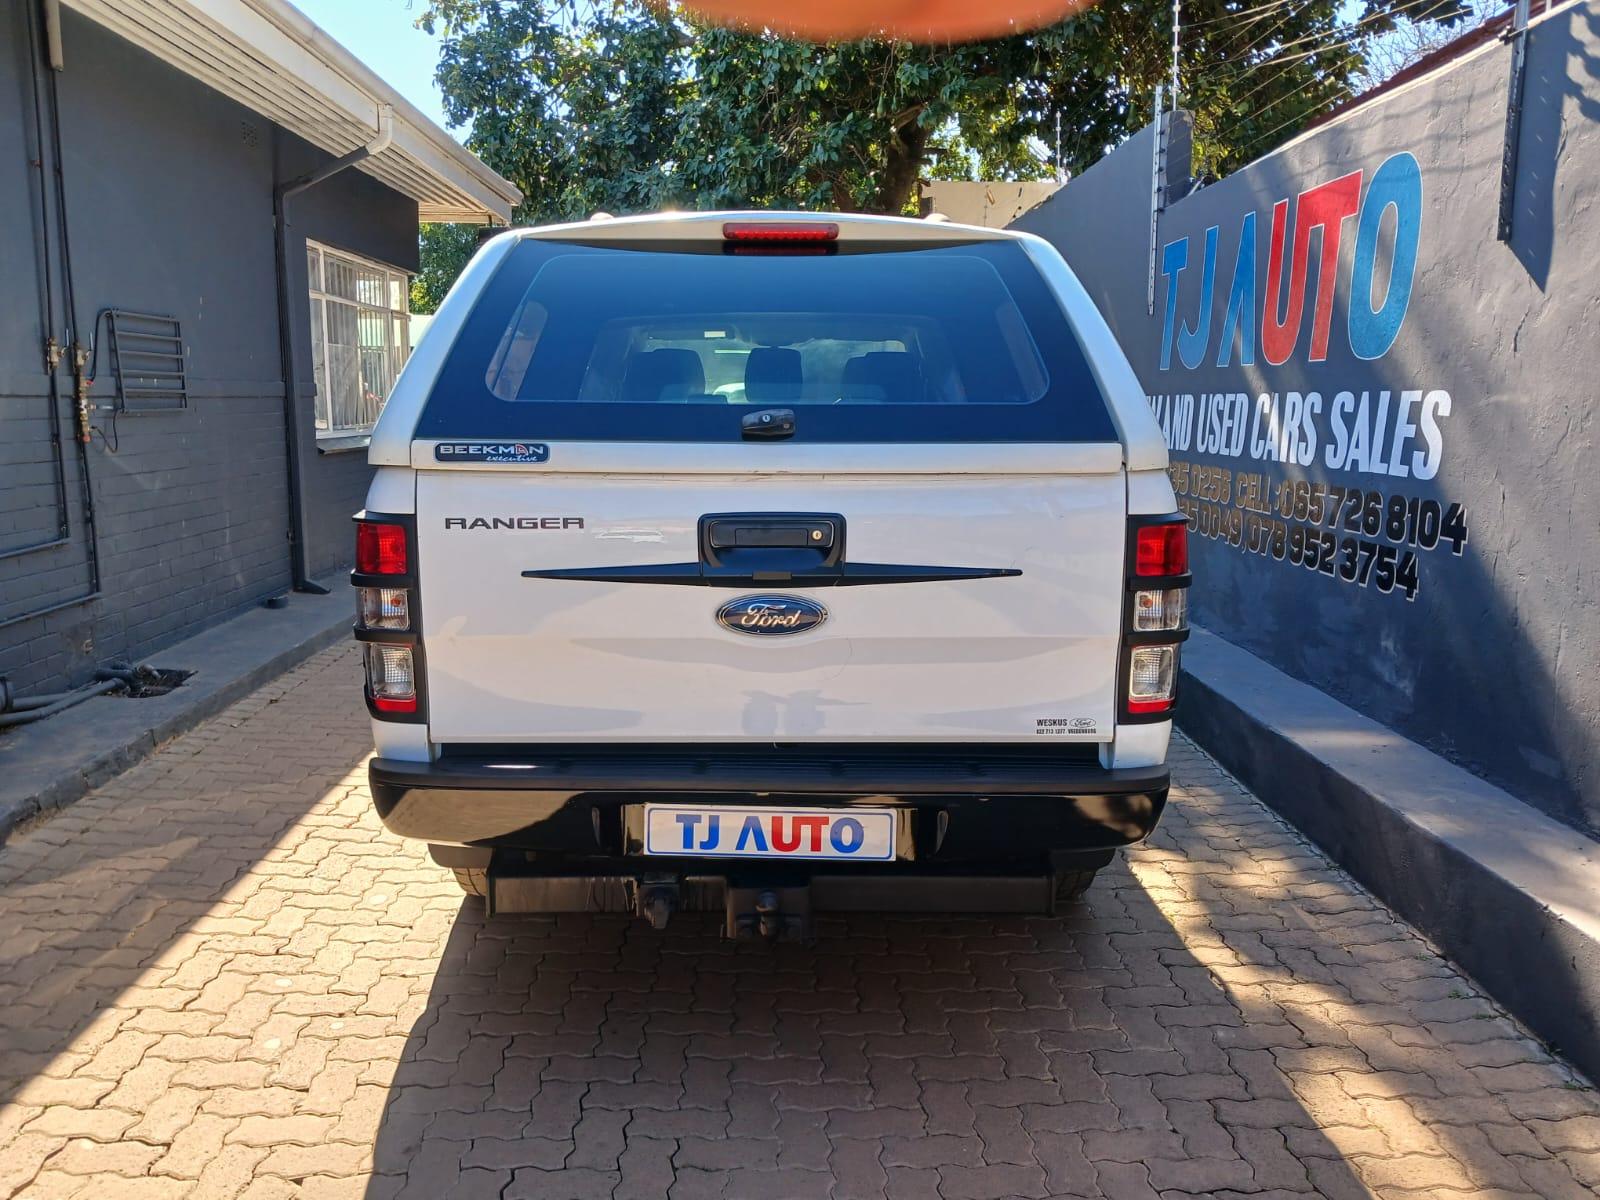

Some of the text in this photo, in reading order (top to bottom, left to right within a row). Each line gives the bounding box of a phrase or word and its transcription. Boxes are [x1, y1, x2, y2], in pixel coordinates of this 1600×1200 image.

[1159, 151, 1424, 371] TJ AUTO
[439, 444, 544, 455] BEEKMAN
[1162, 389, 1452, 481] AND USED CARS SALES
[486, 453, 538, 462] executive
[445, 517, 585, 531] RANGER
[1235, 471, 1272, 516] CELL
[1328, 486, 1384, 538] 726
[1385, 494, 1469, 557] 8104
[1289, 526, 1339, 578] 952
[1339, 538, 1420, 603] 3754
[741, 602, 802, 629] Ford
[1036, 719, 1067, 727] WESKUS
[675, 813, 865, 854] TJ AUTO
